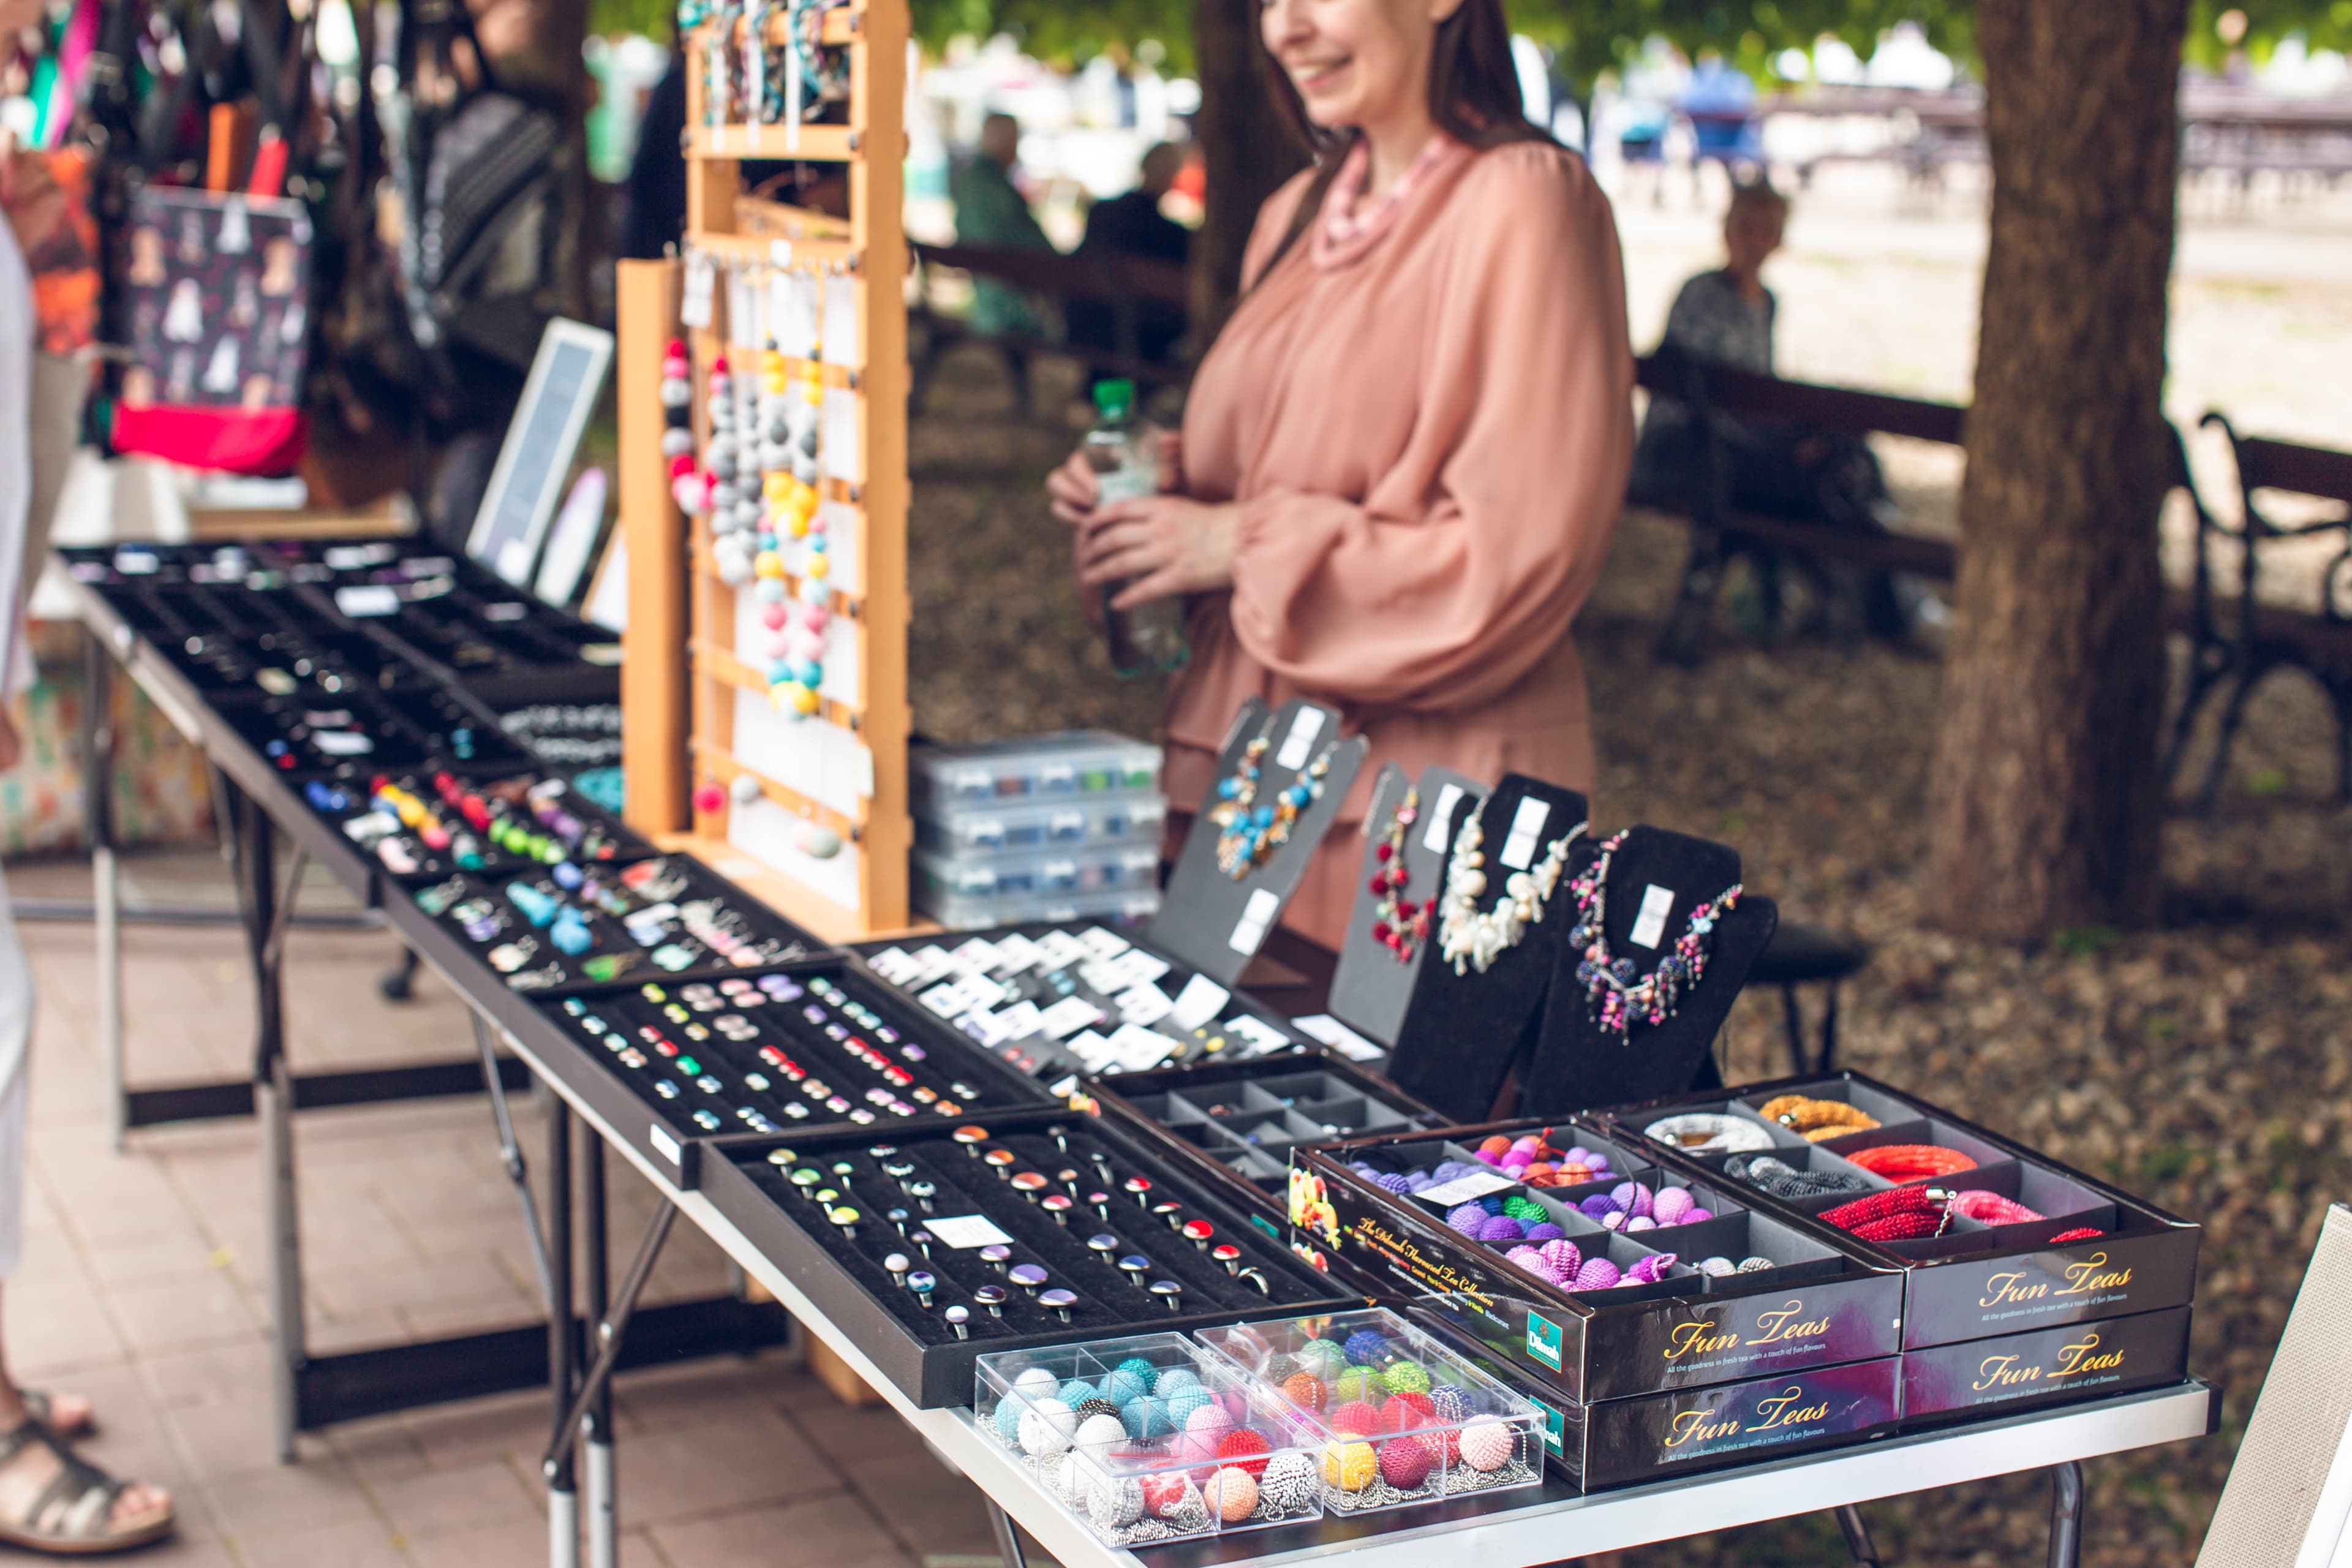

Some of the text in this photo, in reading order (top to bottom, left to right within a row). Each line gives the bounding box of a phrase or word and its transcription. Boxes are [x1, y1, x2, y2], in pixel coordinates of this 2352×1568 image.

[1357, 1217, 1376, 1235] The
[1374, 1227, 1408, 1253] Dilmah
[1404, 1245, 1444, 1276] Flavoured
[1441, 1267, 1459, 1286] Tea
[1459, 1276, 1494, 1306] Collection
[1979, 1251, 2133, 1307] Fun Teas
[1529, 1330, 1559, 1362] Dilmah
[1664, 1300, 1831, 1359] Fun Teas
[1687, 1361, 1715, 1372] goodness
[1722, 1357, 1738, 1366] fresh
[1768, 1349, 1785, 1357] touch
[1793, 1346, 1803, 1355] fun
[1804, 1343, 1826, 1353] flavours
[1972, 1333, 2125, 1391] Fun Teas
[1665, 1386, 1829, 1447] Fun Teas
[1689, 1449, 1715, 1460] goodness
[1722, 1444, 1738, 1453] fresh
[1768, 1434, 1784, 1443] touch
[1792, 1431, 1802, 1440] fun
[1803, 1428, 1825, 1439] flavours
